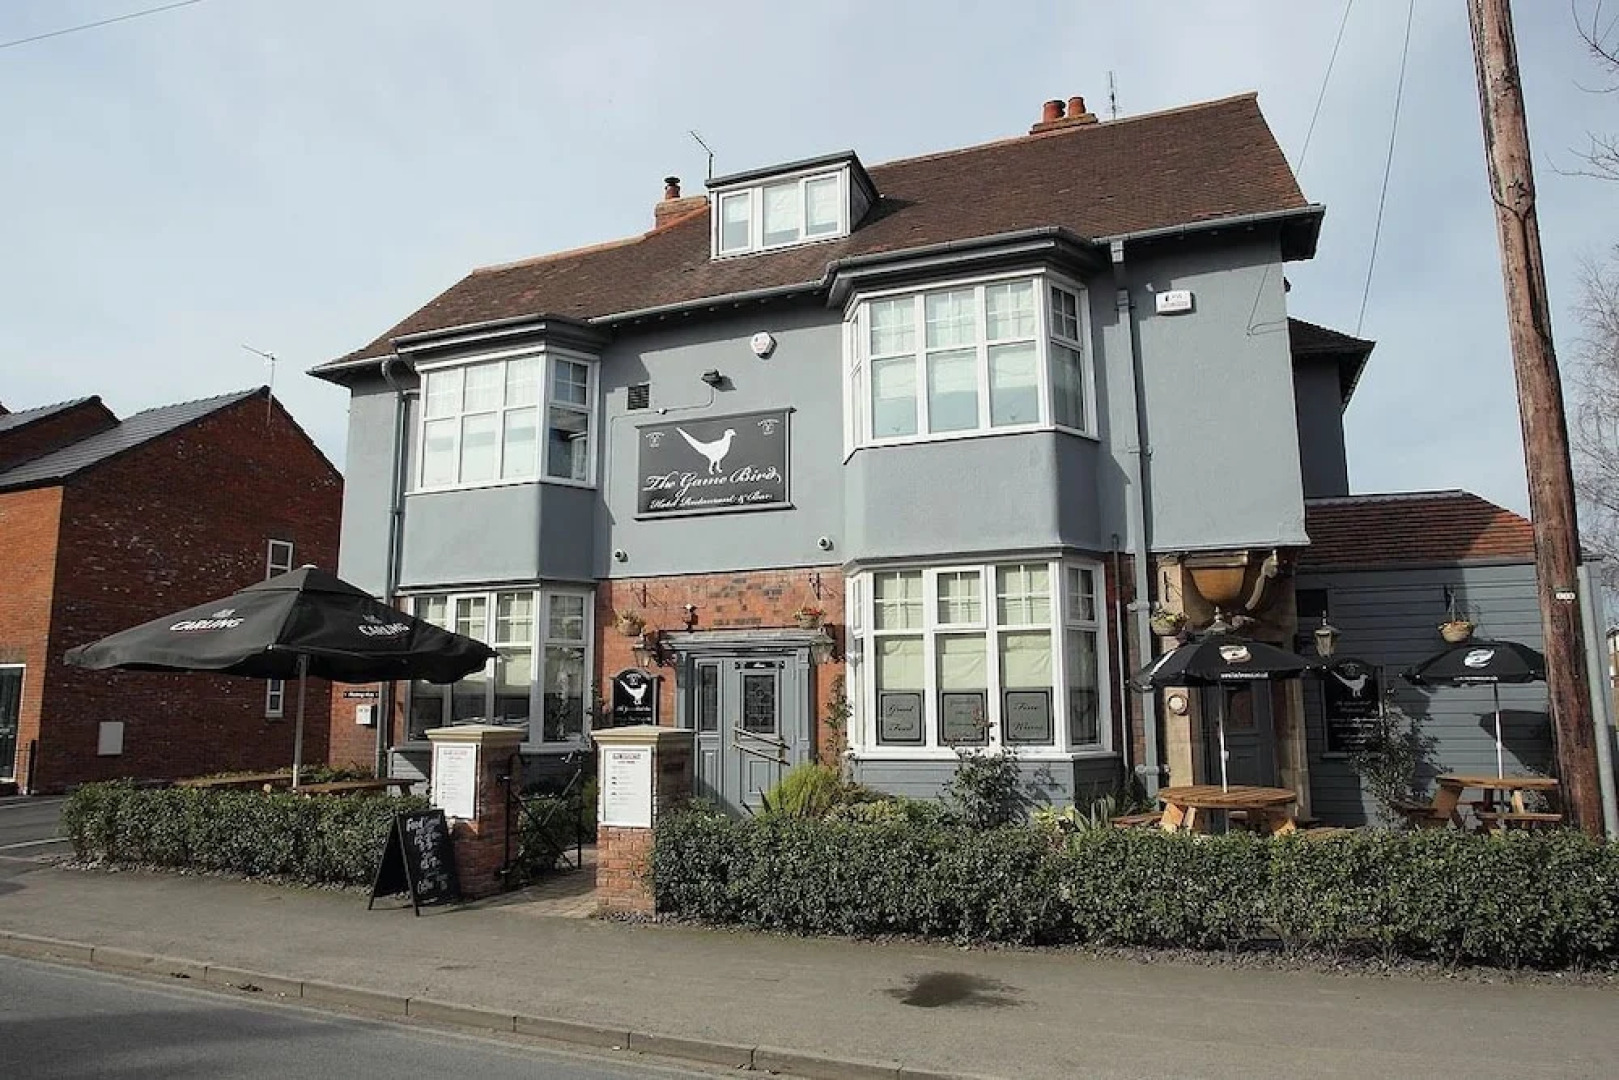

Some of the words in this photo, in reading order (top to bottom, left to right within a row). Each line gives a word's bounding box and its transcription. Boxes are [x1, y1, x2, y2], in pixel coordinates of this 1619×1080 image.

[643, 471, 679, 491] The
[675, 472, 728, 500] Game
[730, 466, 781, 484] Bird
[169, 619, 245, 631] CARLING
[358, 622, 410, 636] CARLING
